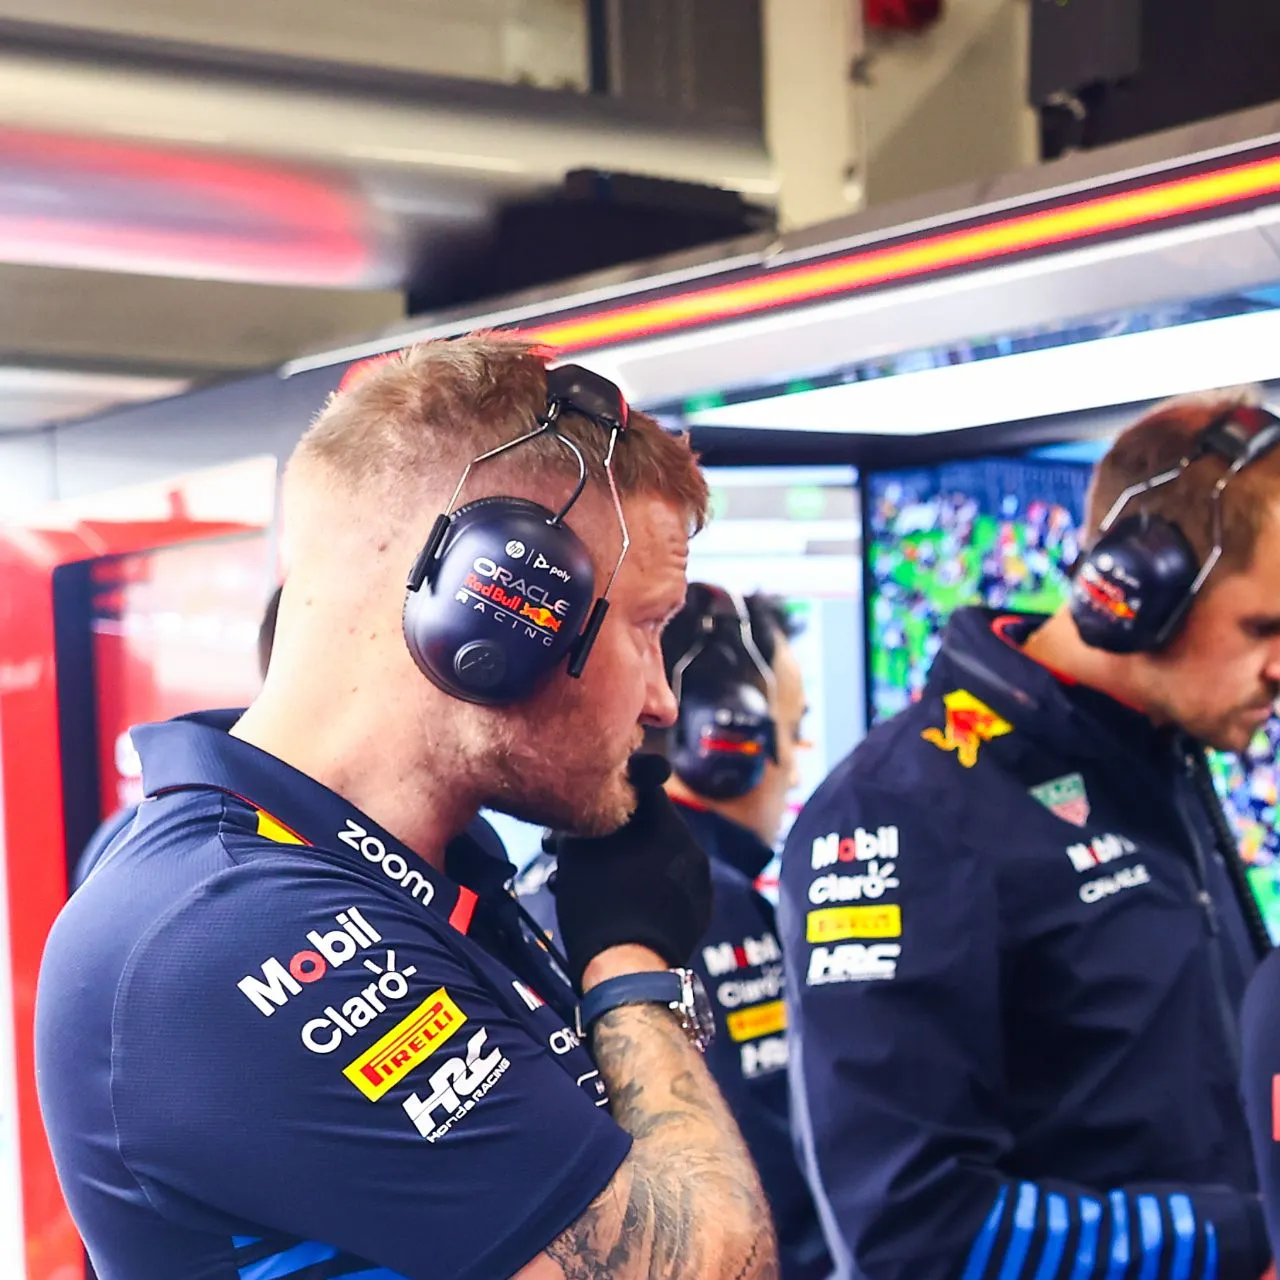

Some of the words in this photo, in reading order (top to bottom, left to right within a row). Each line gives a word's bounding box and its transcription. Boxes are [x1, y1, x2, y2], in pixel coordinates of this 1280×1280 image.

[455, 592, 554, 647] RACING
[463, 573, 494, 597] Red
[493, 584, 523, 611] Bull
[473, 557, 570, 616] ORACLE
[337, 819, 435, 906] zoom
[811, 826, 899, 870] Mobil
[236, 906, 382, 1017] Mobil
[301, 969, 408, 1054] Claro
[360, 1001, 454, 1087] PIRELLI
[402, 1026, 503, 1138] HRC
[426, 1096, 476, 1143] Honda
[471, 1057, 511, 1102] RACING
